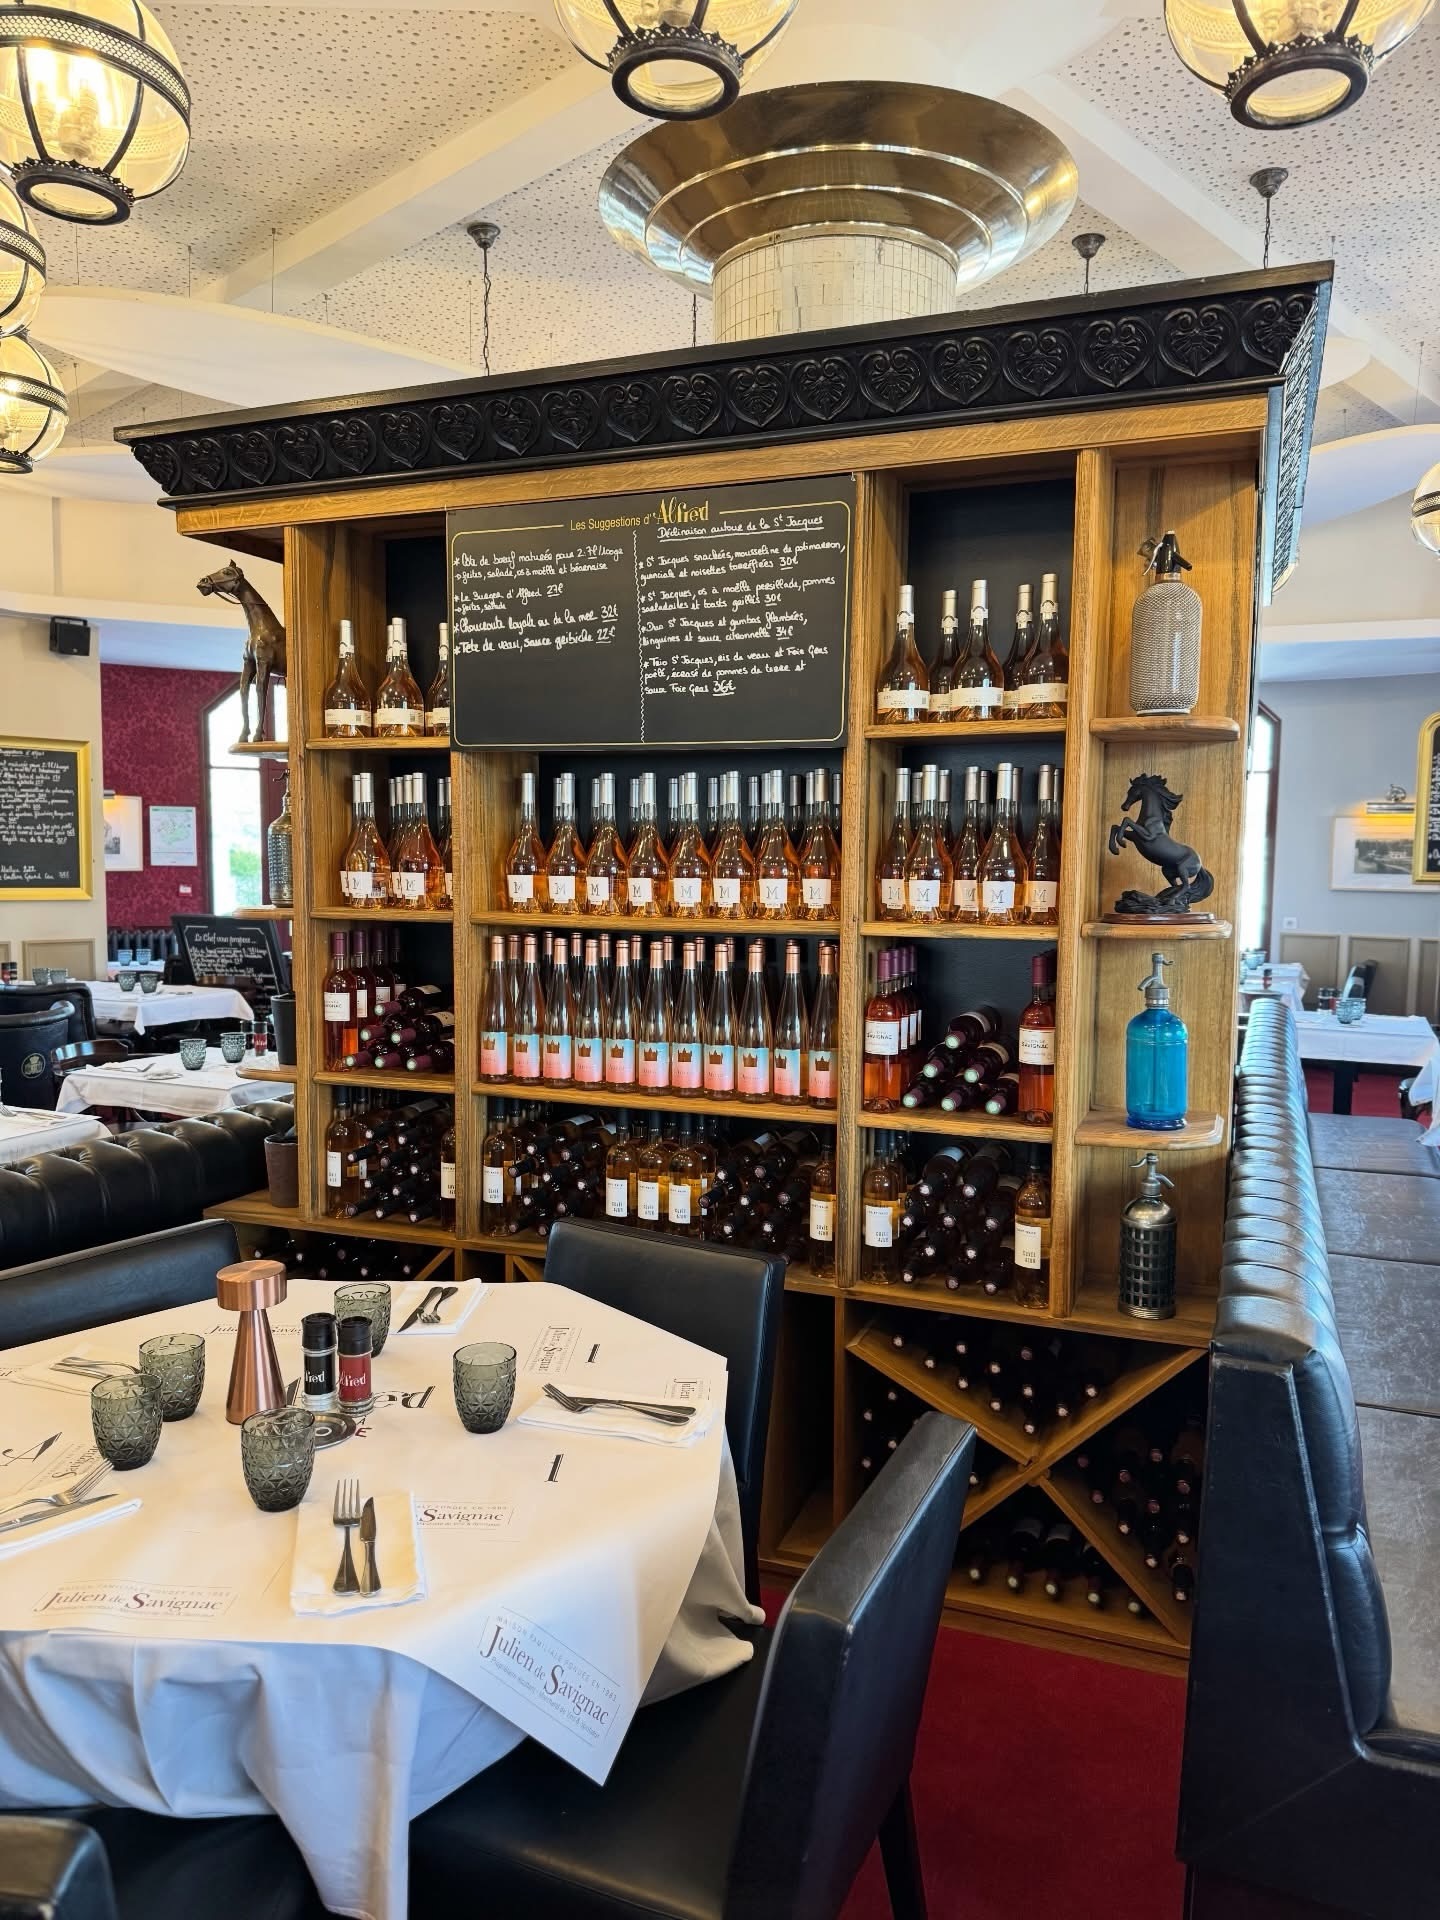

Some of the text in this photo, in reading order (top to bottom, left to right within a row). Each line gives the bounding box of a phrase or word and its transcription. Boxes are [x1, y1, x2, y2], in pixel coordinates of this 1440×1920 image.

[570, 519, 586, 531] Les
[588, 516, 641, 532] Suggestions
[657, 526, 707, 539] Déclinaison
[711, 521, 744, 534] autour
[746, 521, 757, 531] de
[759, 517, 771, 530] la
[786, 515, 823, 531] Jacques
[479, 554, 490, 567] de
[555, 551, 575, 565] pour
[658, 555, 689, 569] Jacques
[735, 544, 780, 558] mousseline
[782, 543, 793, 554] de
[558, 563, 568, 575] et
[570, 562, 608, 573] béarnaise
[678, 567, 688, 578] et
[690, 565, 727, 577] noisettes
[697, 587, 708, 596] os
[711, 586, 719, 595] à
[802, 576, 836, 592] pommes
[460, 592, 472, 603] Le
[690, 599, 701, 611] et
[703, 597, 728, 609] toasts
[553, 611, 563, 626] de
[564, 608, 576, 624] la
[578, 610, 599, 623] mer
[679, 617, 715, 632] Jacques
[718, 615, 727, 627] et
[729, 614, 762, 632] gambas
[482, 637, 495, 652] de
[523, 637, 553, 648] sauce
[683, 631, 693, 642] et
[697, 634, 722, 643] sauce
[733, 651, 743, 661] de
[746, 652, 771, 660] veau
[774, 645, 785, 658] et
[701, 668, 713, 678] de
[716, 666, 749, 681] pommes
[750, 664, 763, 674] de
[765, 663, 791, 673] terre
[794, 659, 807, 672] et
[669, 682, 687, 693] Foie
[418, 1508, 505, 1523] Savignac
[33, 1591, 107, 1612] Julien
[126, 1591, 224, 1614] Savignac
[479, 1623, 610, 1725] Julien de Savignac
